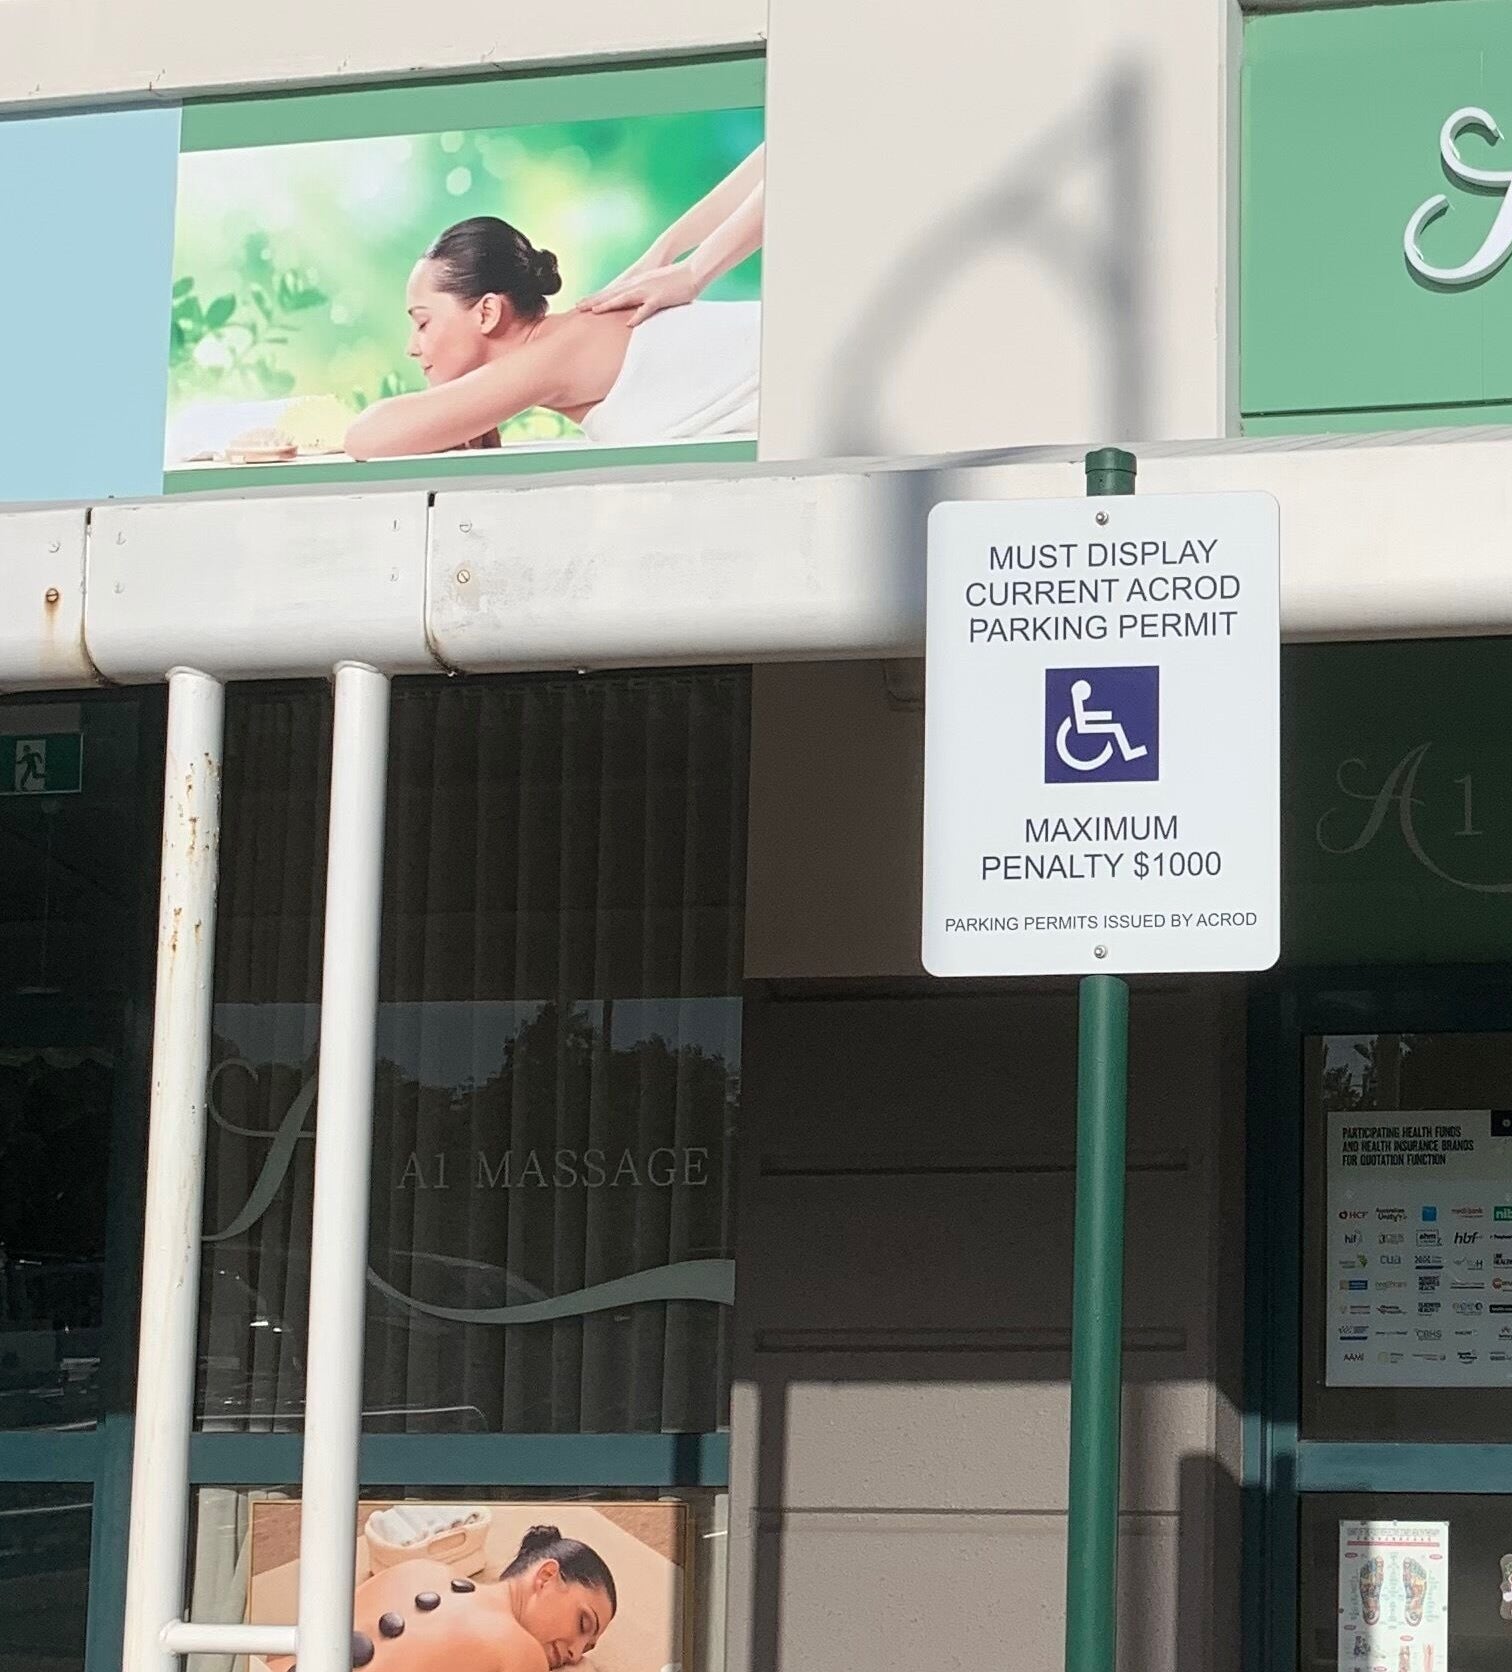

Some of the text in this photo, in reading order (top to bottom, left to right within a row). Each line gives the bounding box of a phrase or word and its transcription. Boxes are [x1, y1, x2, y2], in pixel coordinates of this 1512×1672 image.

[990, 539, 1219, 571] MUST DISPLAY
[965, 575, 1241, 607] CURRENT ACROD
[969, 612, 1237, 642] PARKING PERMIT
[1025, 815, 1178, 843] MAXIMUM
[983, 850, 1221, 880] PENALTY $1000
[945, 912, 1257, 933] PARKING PERMITS ISSUED BY ACROD
[1342, 1126, 1461, 1138] PARTICIPATING HEALTH FUNDS
[1342, 1140, 1474, 1151] AND HEALTH INSURANCE BRANDS
[397, 1147, 709, 1190] A1 MASSAGE
[1342, 1154, 1446, 1166] FOR QUOTATION FUNCTION
[1454, 1231, 1479, 1244] hbf
[1380, 1255, 1401, 1264] cua
